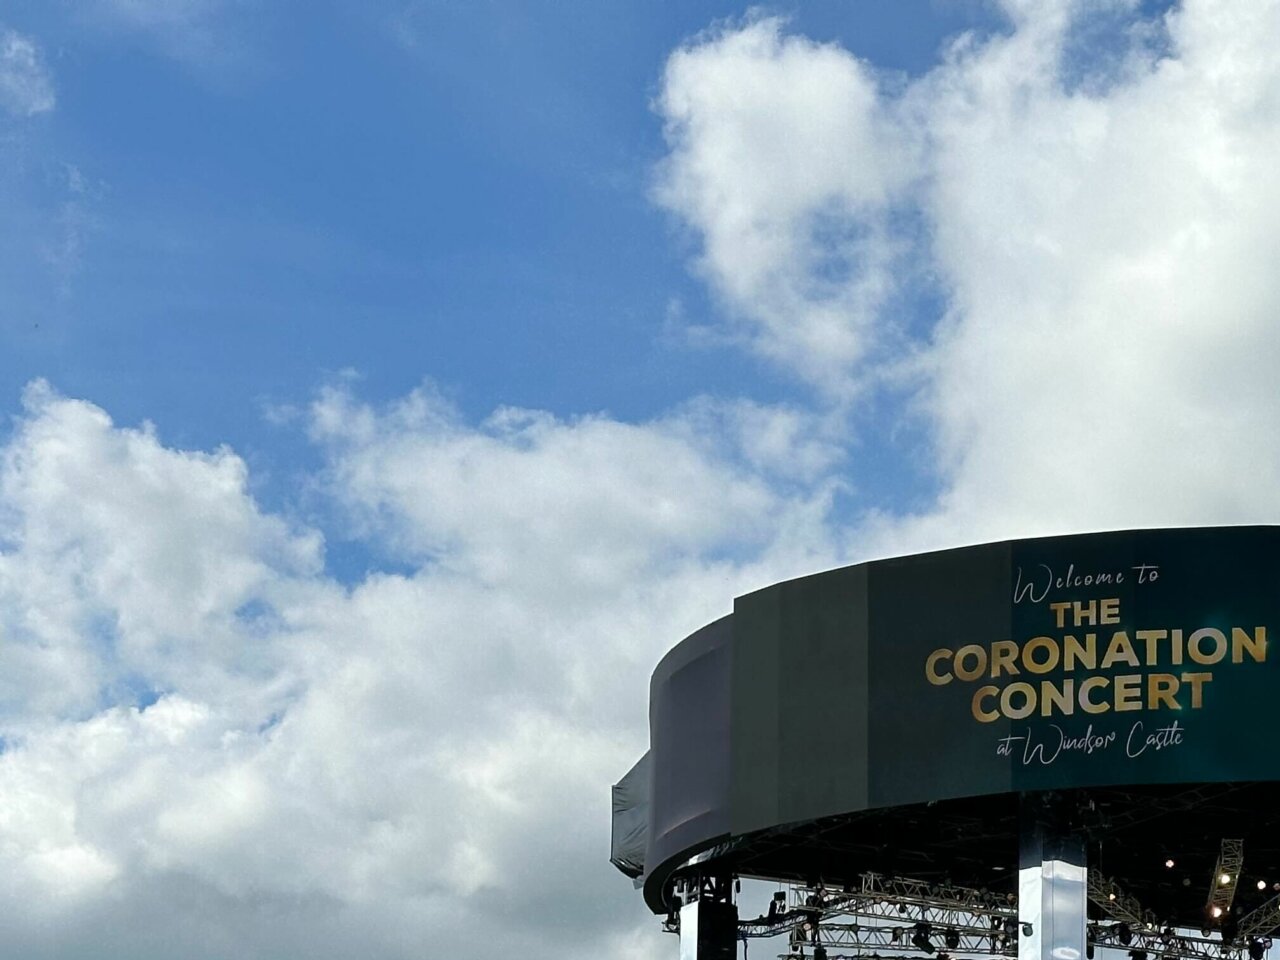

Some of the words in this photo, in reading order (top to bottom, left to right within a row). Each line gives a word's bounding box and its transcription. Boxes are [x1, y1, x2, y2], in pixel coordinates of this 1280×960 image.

[1013, 564, 1125, 605] Welcome
[1132, 564, 1160, 585] to
[1050, 597, 1121, 629] THE
[925, 626, 1268, 686] CORONATION
[971, 672, 1214, 724] CONCERT
[996, 735, 1025, 758] at
[1021, 723, 1117, 766] Windsor
[1126, 720, 1185, 759] Castle
